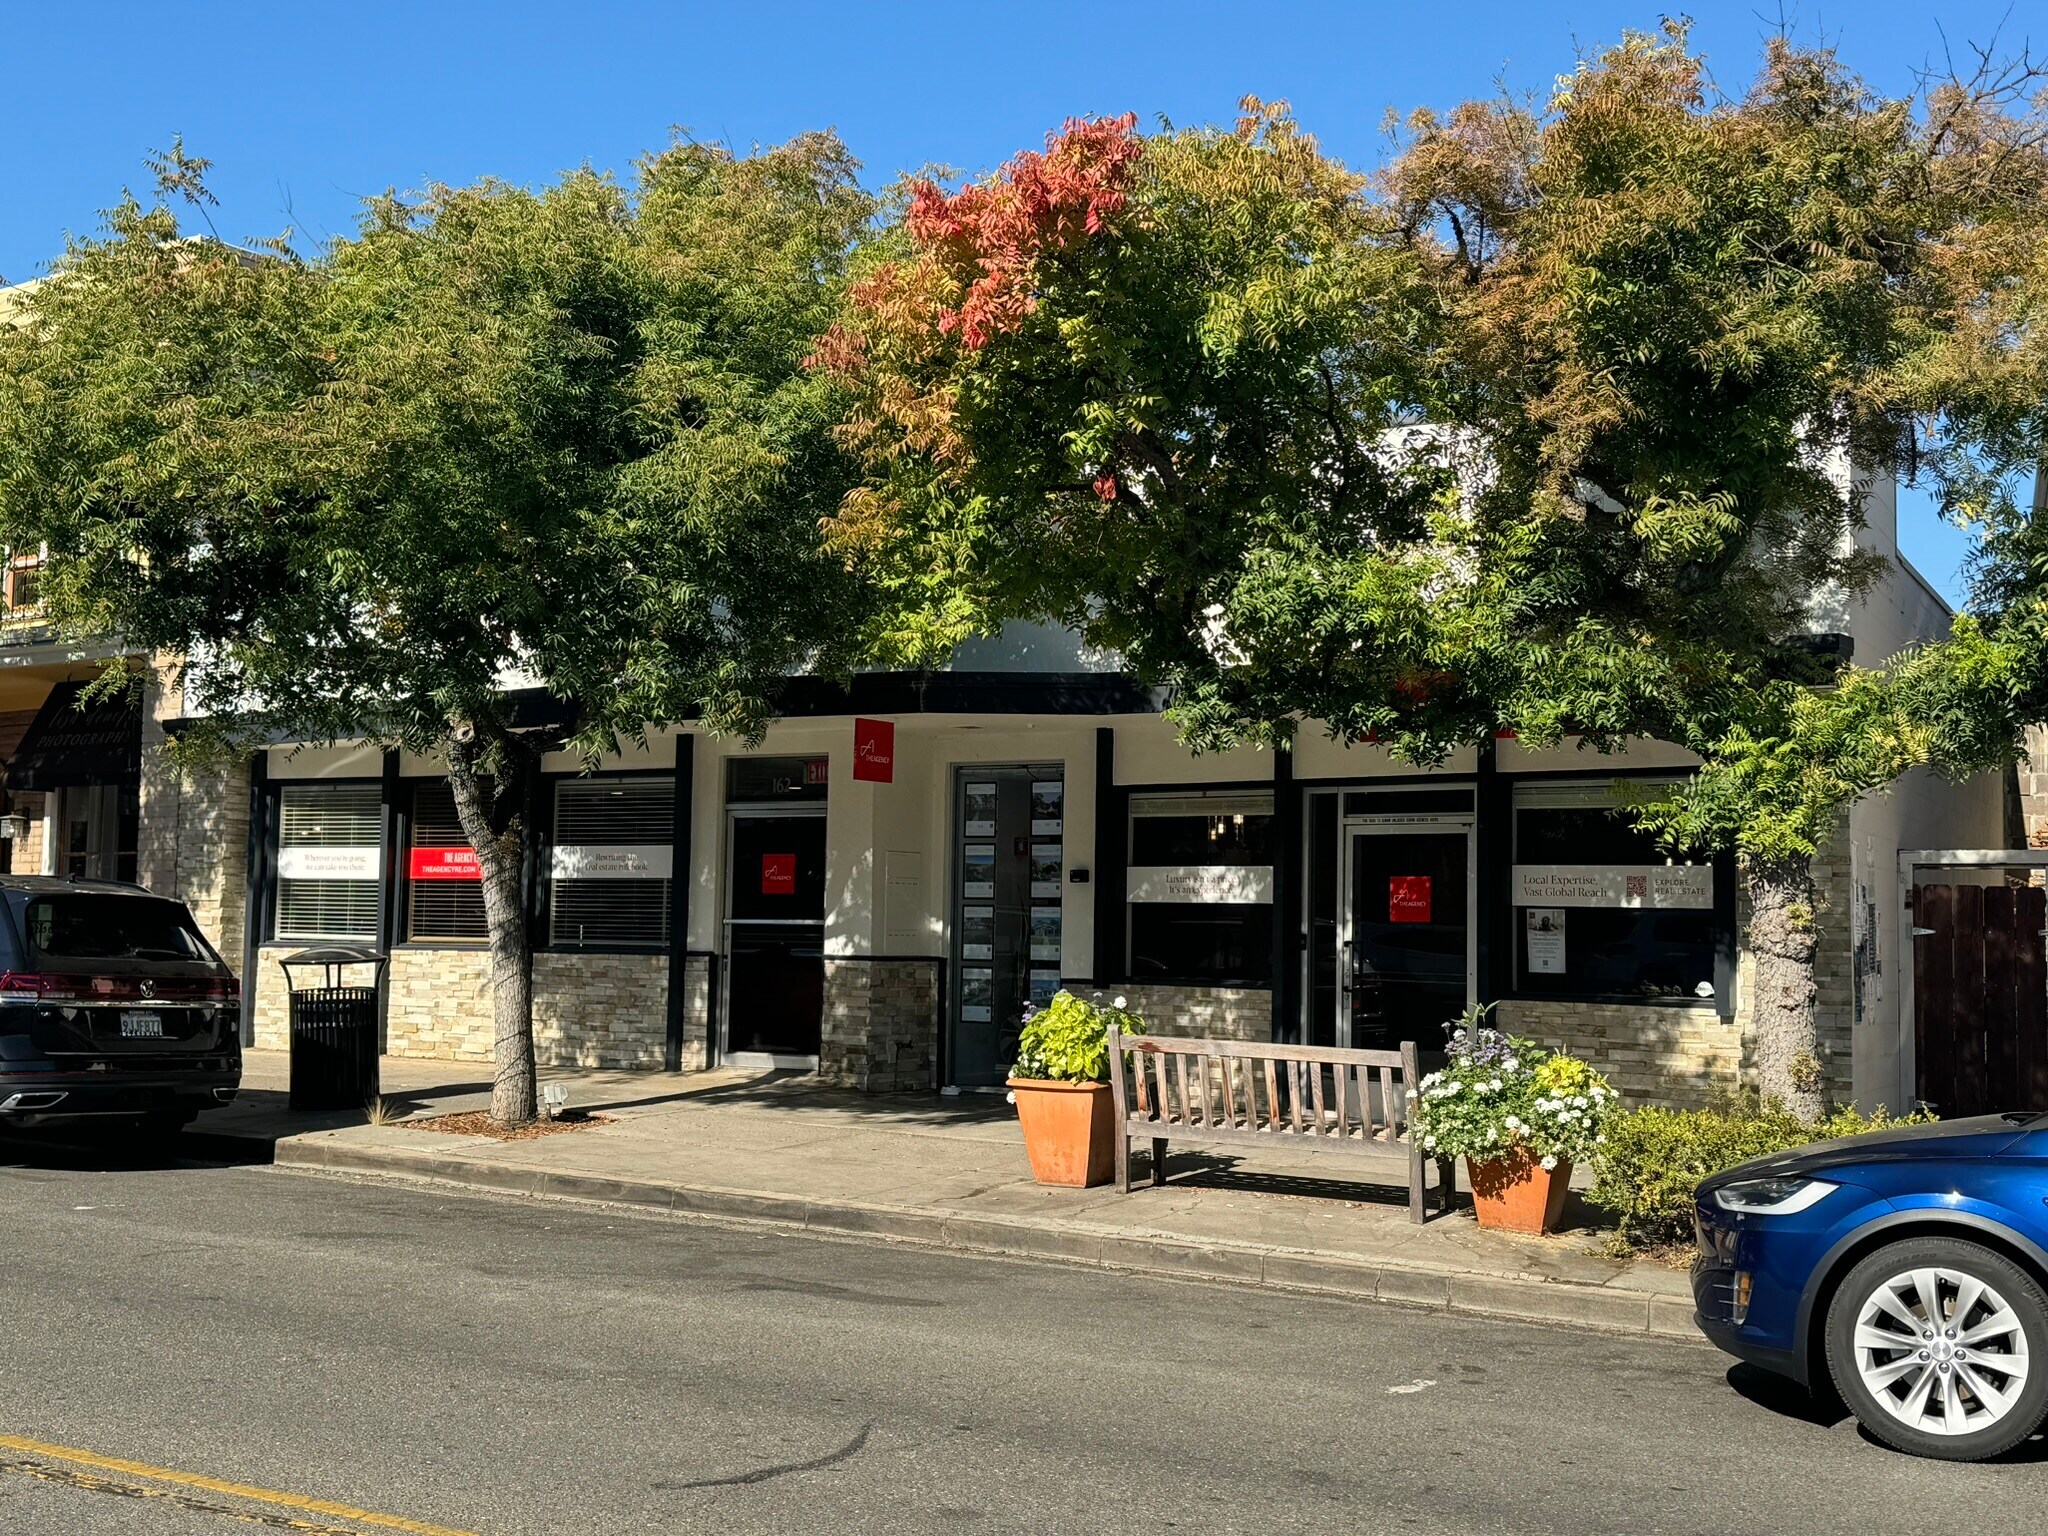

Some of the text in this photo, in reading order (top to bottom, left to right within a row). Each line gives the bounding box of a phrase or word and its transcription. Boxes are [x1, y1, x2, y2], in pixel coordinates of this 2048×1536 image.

[773, 777, 791, 793] 162
[454, 852, 473, 864] AGENCY
[1523, 875, 1599, 886] Local Expertise,
[1169, 885, 1180, 894] It's
[1524, 887, 1607, 898] Vast Global Reach
